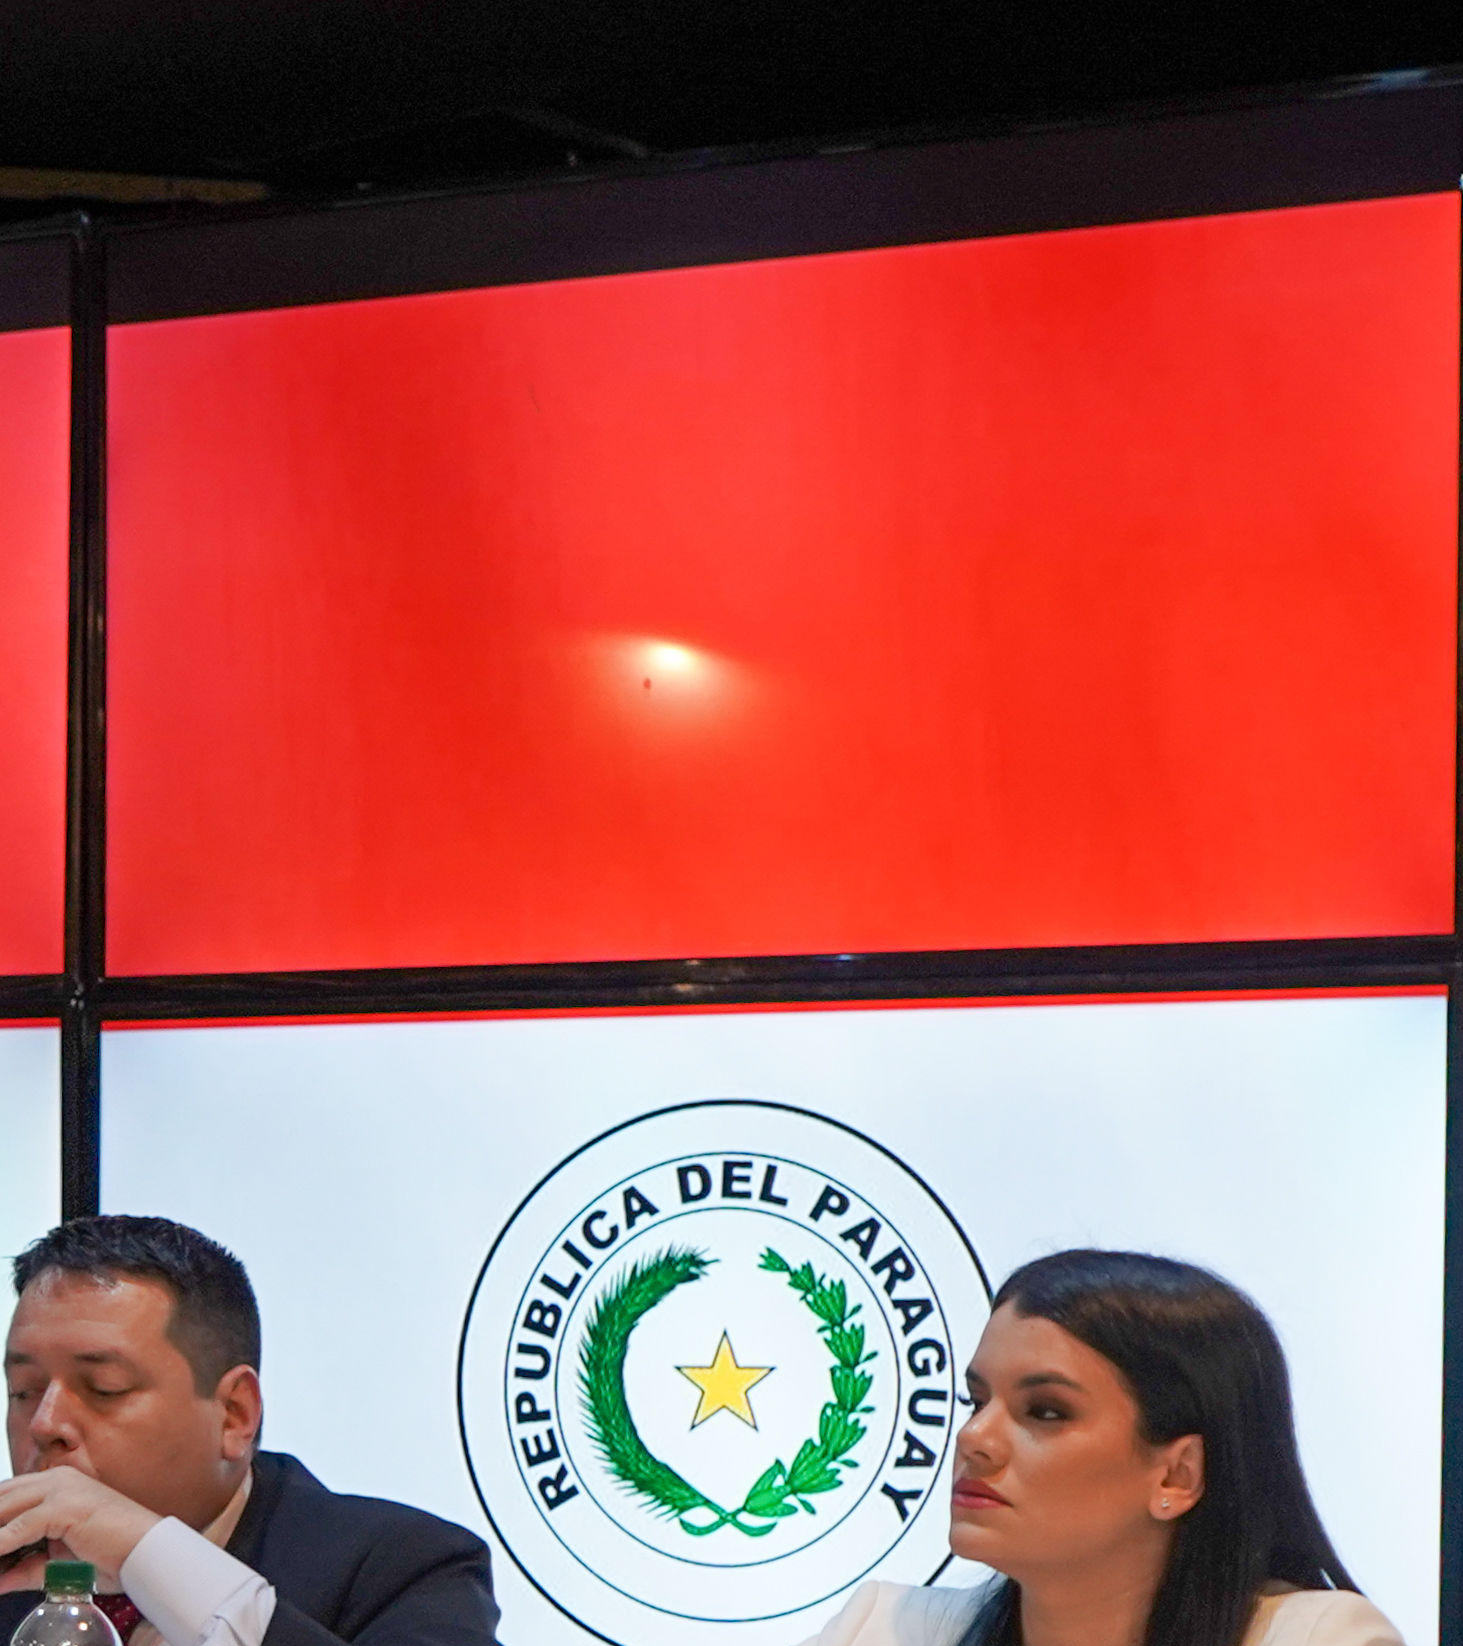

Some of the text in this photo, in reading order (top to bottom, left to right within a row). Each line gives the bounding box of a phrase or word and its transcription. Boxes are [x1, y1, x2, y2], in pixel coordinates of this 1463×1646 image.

[515, 1160, 948, 1522] REPUBLICA DEL PARAGUAY
